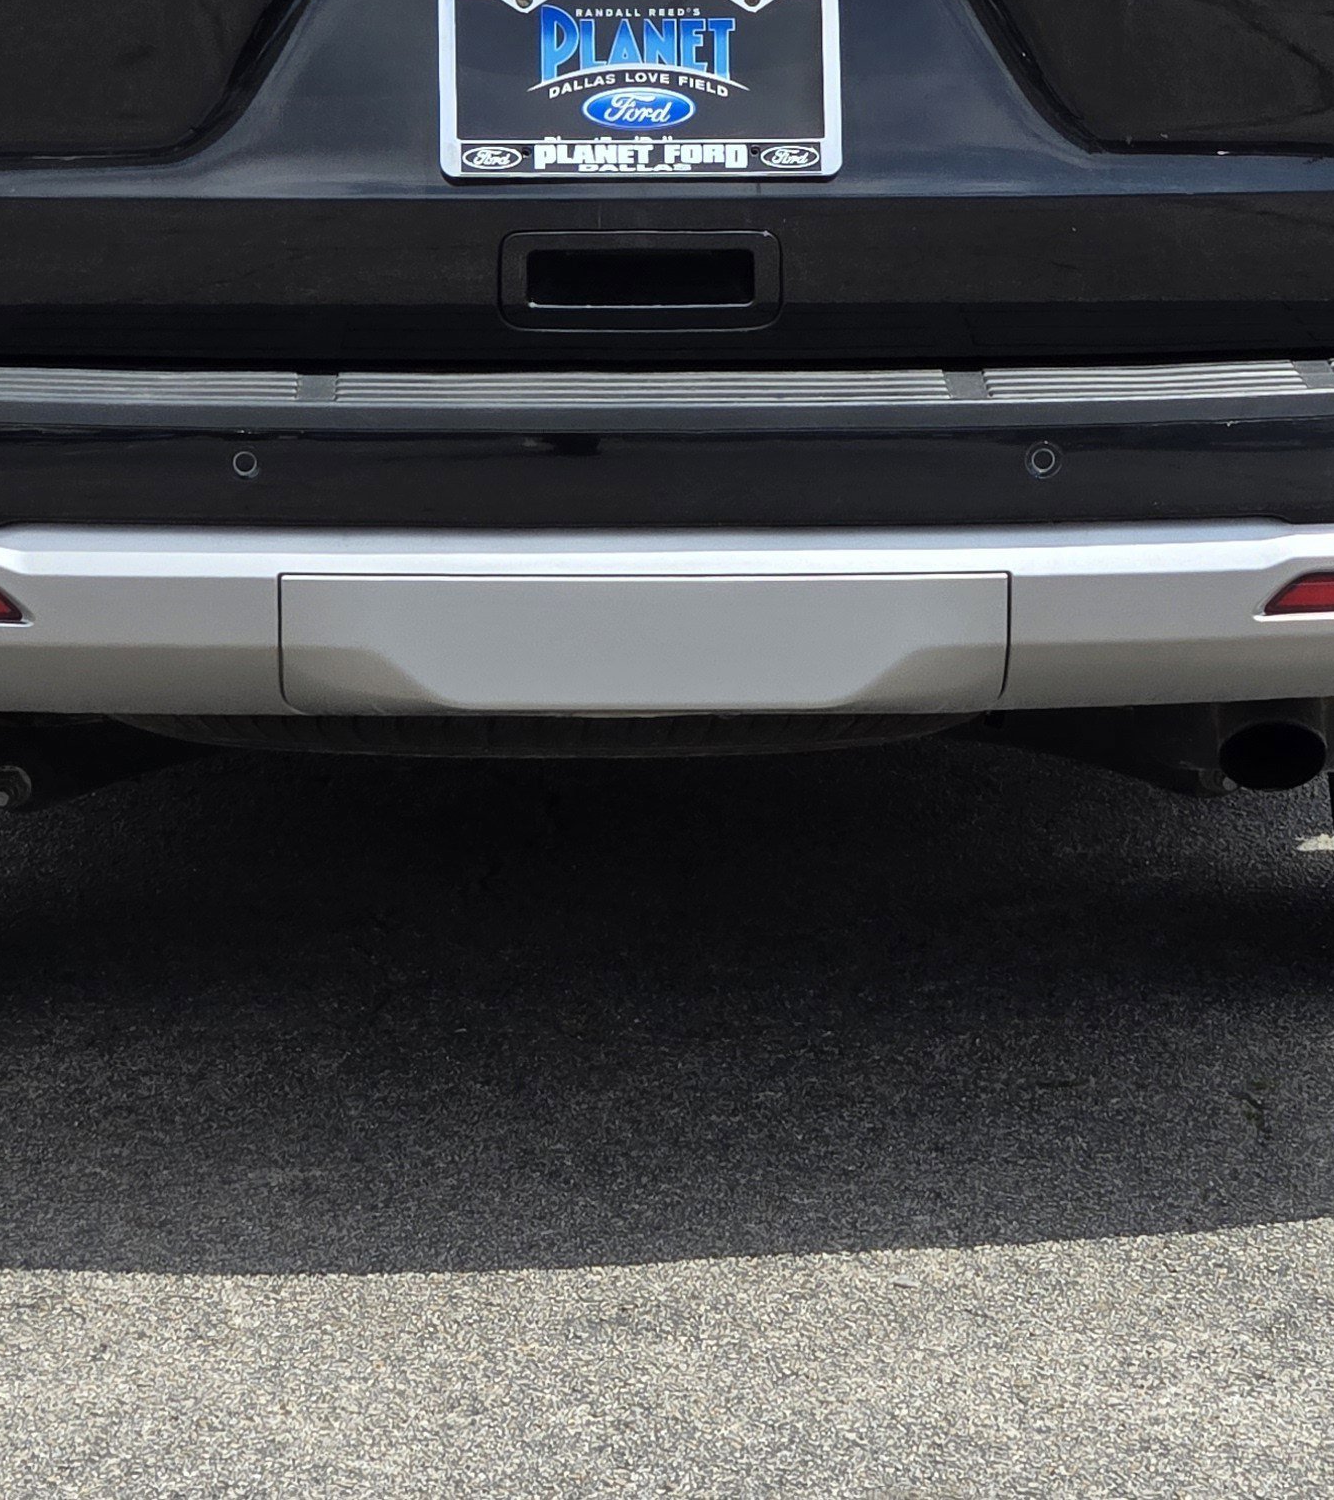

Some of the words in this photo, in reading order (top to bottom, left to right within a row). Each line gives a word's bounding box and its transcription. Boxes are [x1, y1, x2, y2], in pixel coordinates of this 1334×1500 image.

[575, 8, 641, 17] RANDALL
[540, 4, 736, 84] PLANET
[548, 72, 616, 99] DALLAS
[625, 72, 670, 85] LOVE
[678, 75, 729, 98] FIELD
[603, 93, 673, 122] Ford
[472, 149, 512, 165] Ford
[534, 144, 654, 169] PLANET
[664, 143, 747, 168] FORD
[771, 148, 809, 165] Ford
[578, 163, 692, 172] DALLAS
